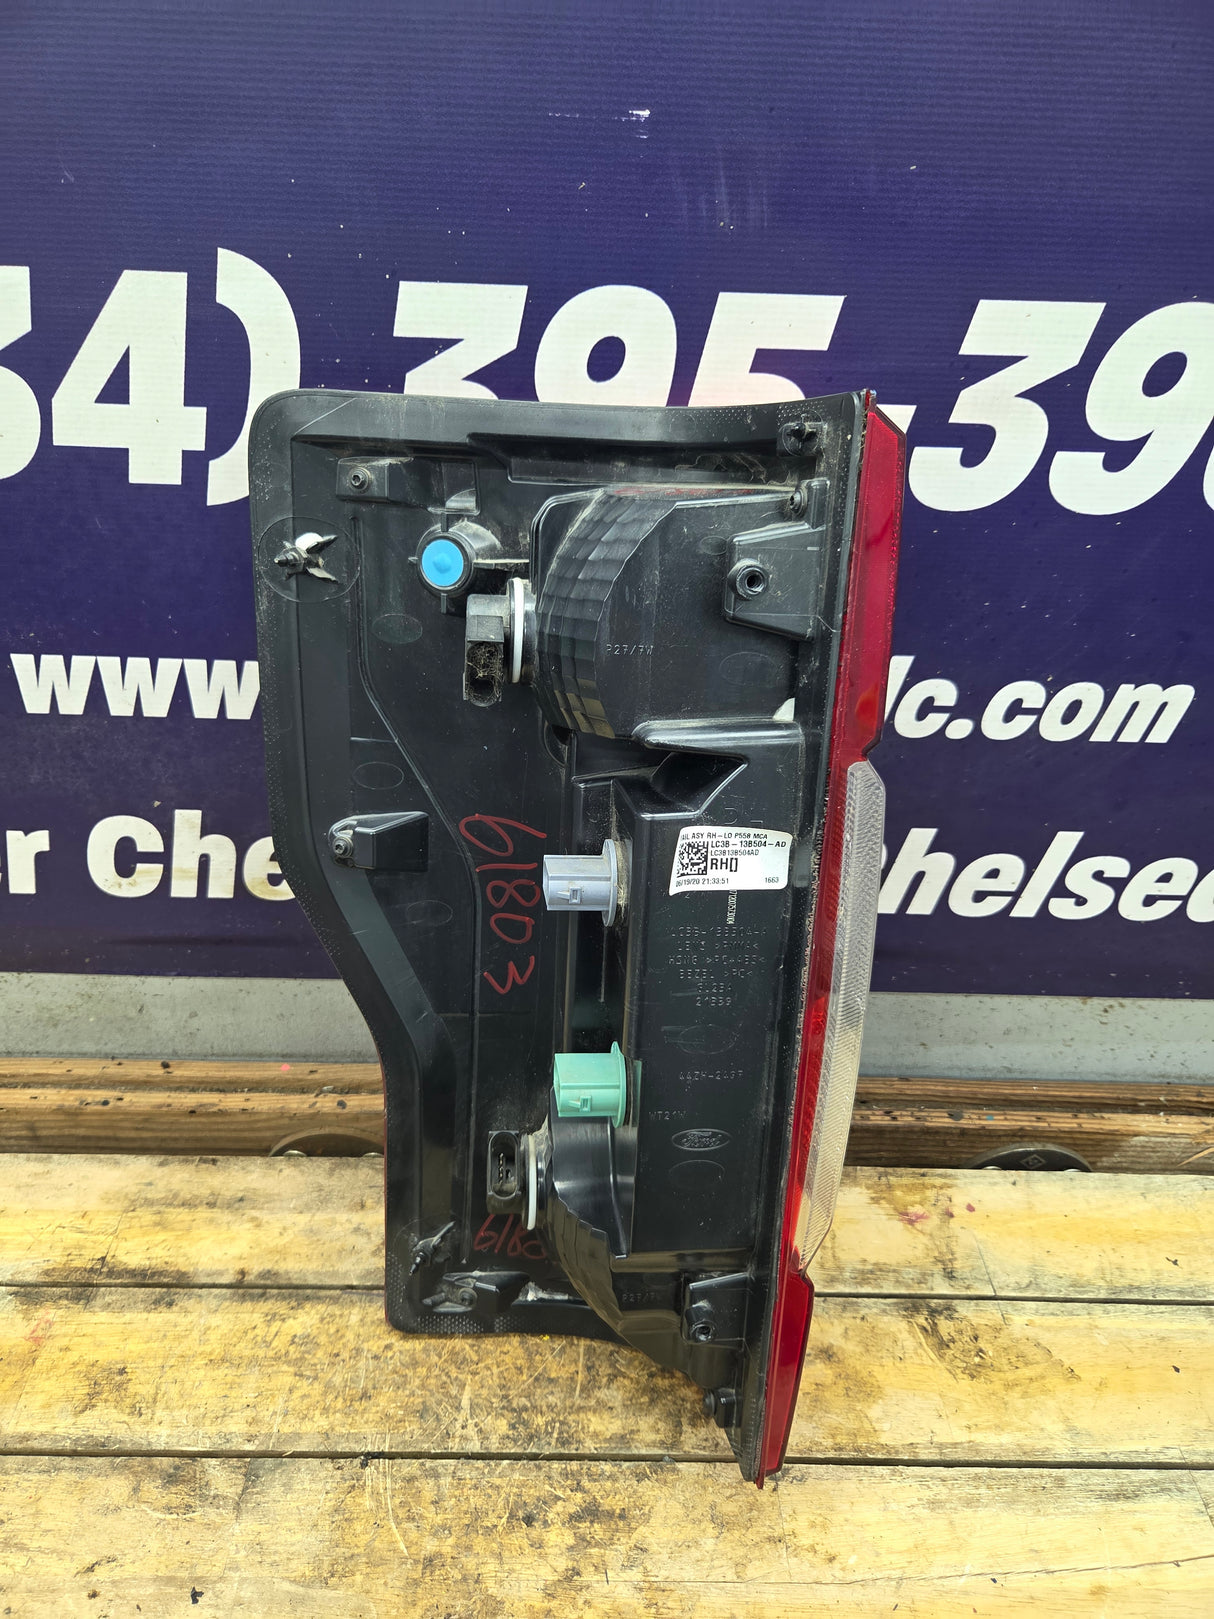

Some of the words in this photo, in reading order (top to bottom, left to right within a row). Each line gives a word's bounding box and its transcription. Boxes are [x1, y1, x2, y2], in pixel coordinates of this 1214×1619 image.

[0, 829, 50, 895] r
[877, 827, 1214, 923] helse
[710, 849, 760, 857] LC3B13B504AD
[458, 813, 547, 994] 61803
[701, 877, 729, 885] 21:33:51
